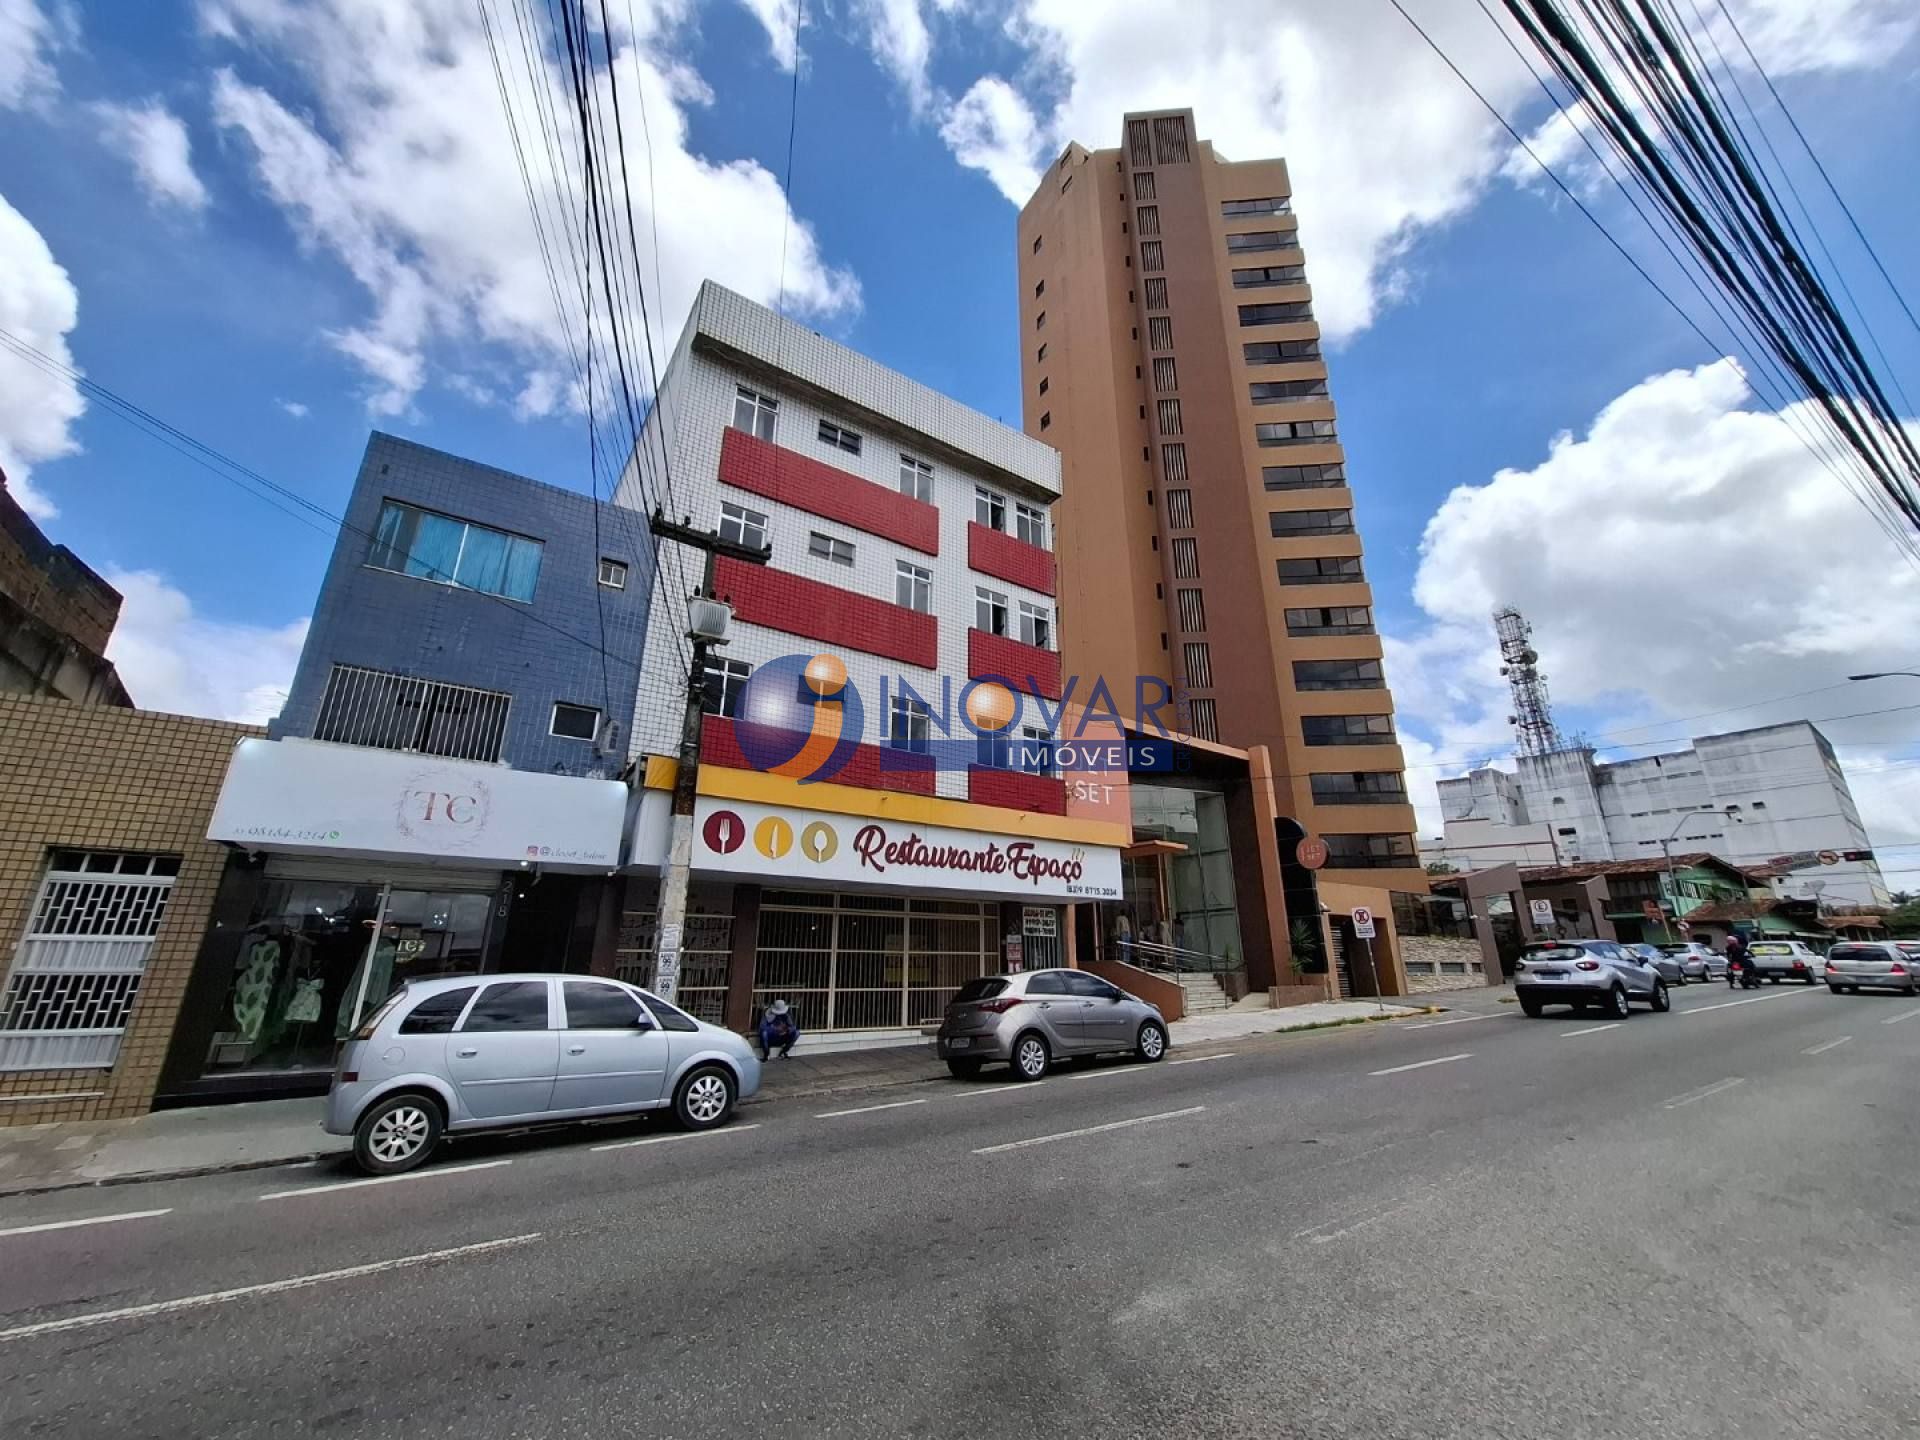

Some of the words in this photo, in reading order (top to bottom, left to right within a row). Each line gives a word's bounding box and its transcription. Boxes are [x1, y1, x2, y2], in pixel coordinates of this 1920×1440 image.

[413, 790, 477, 824] TC
[1075, 779, 1113, 806] SET
[853, 824, 1006, 875] Restaurante
[1006, 841, 1083, 885] Espaço
